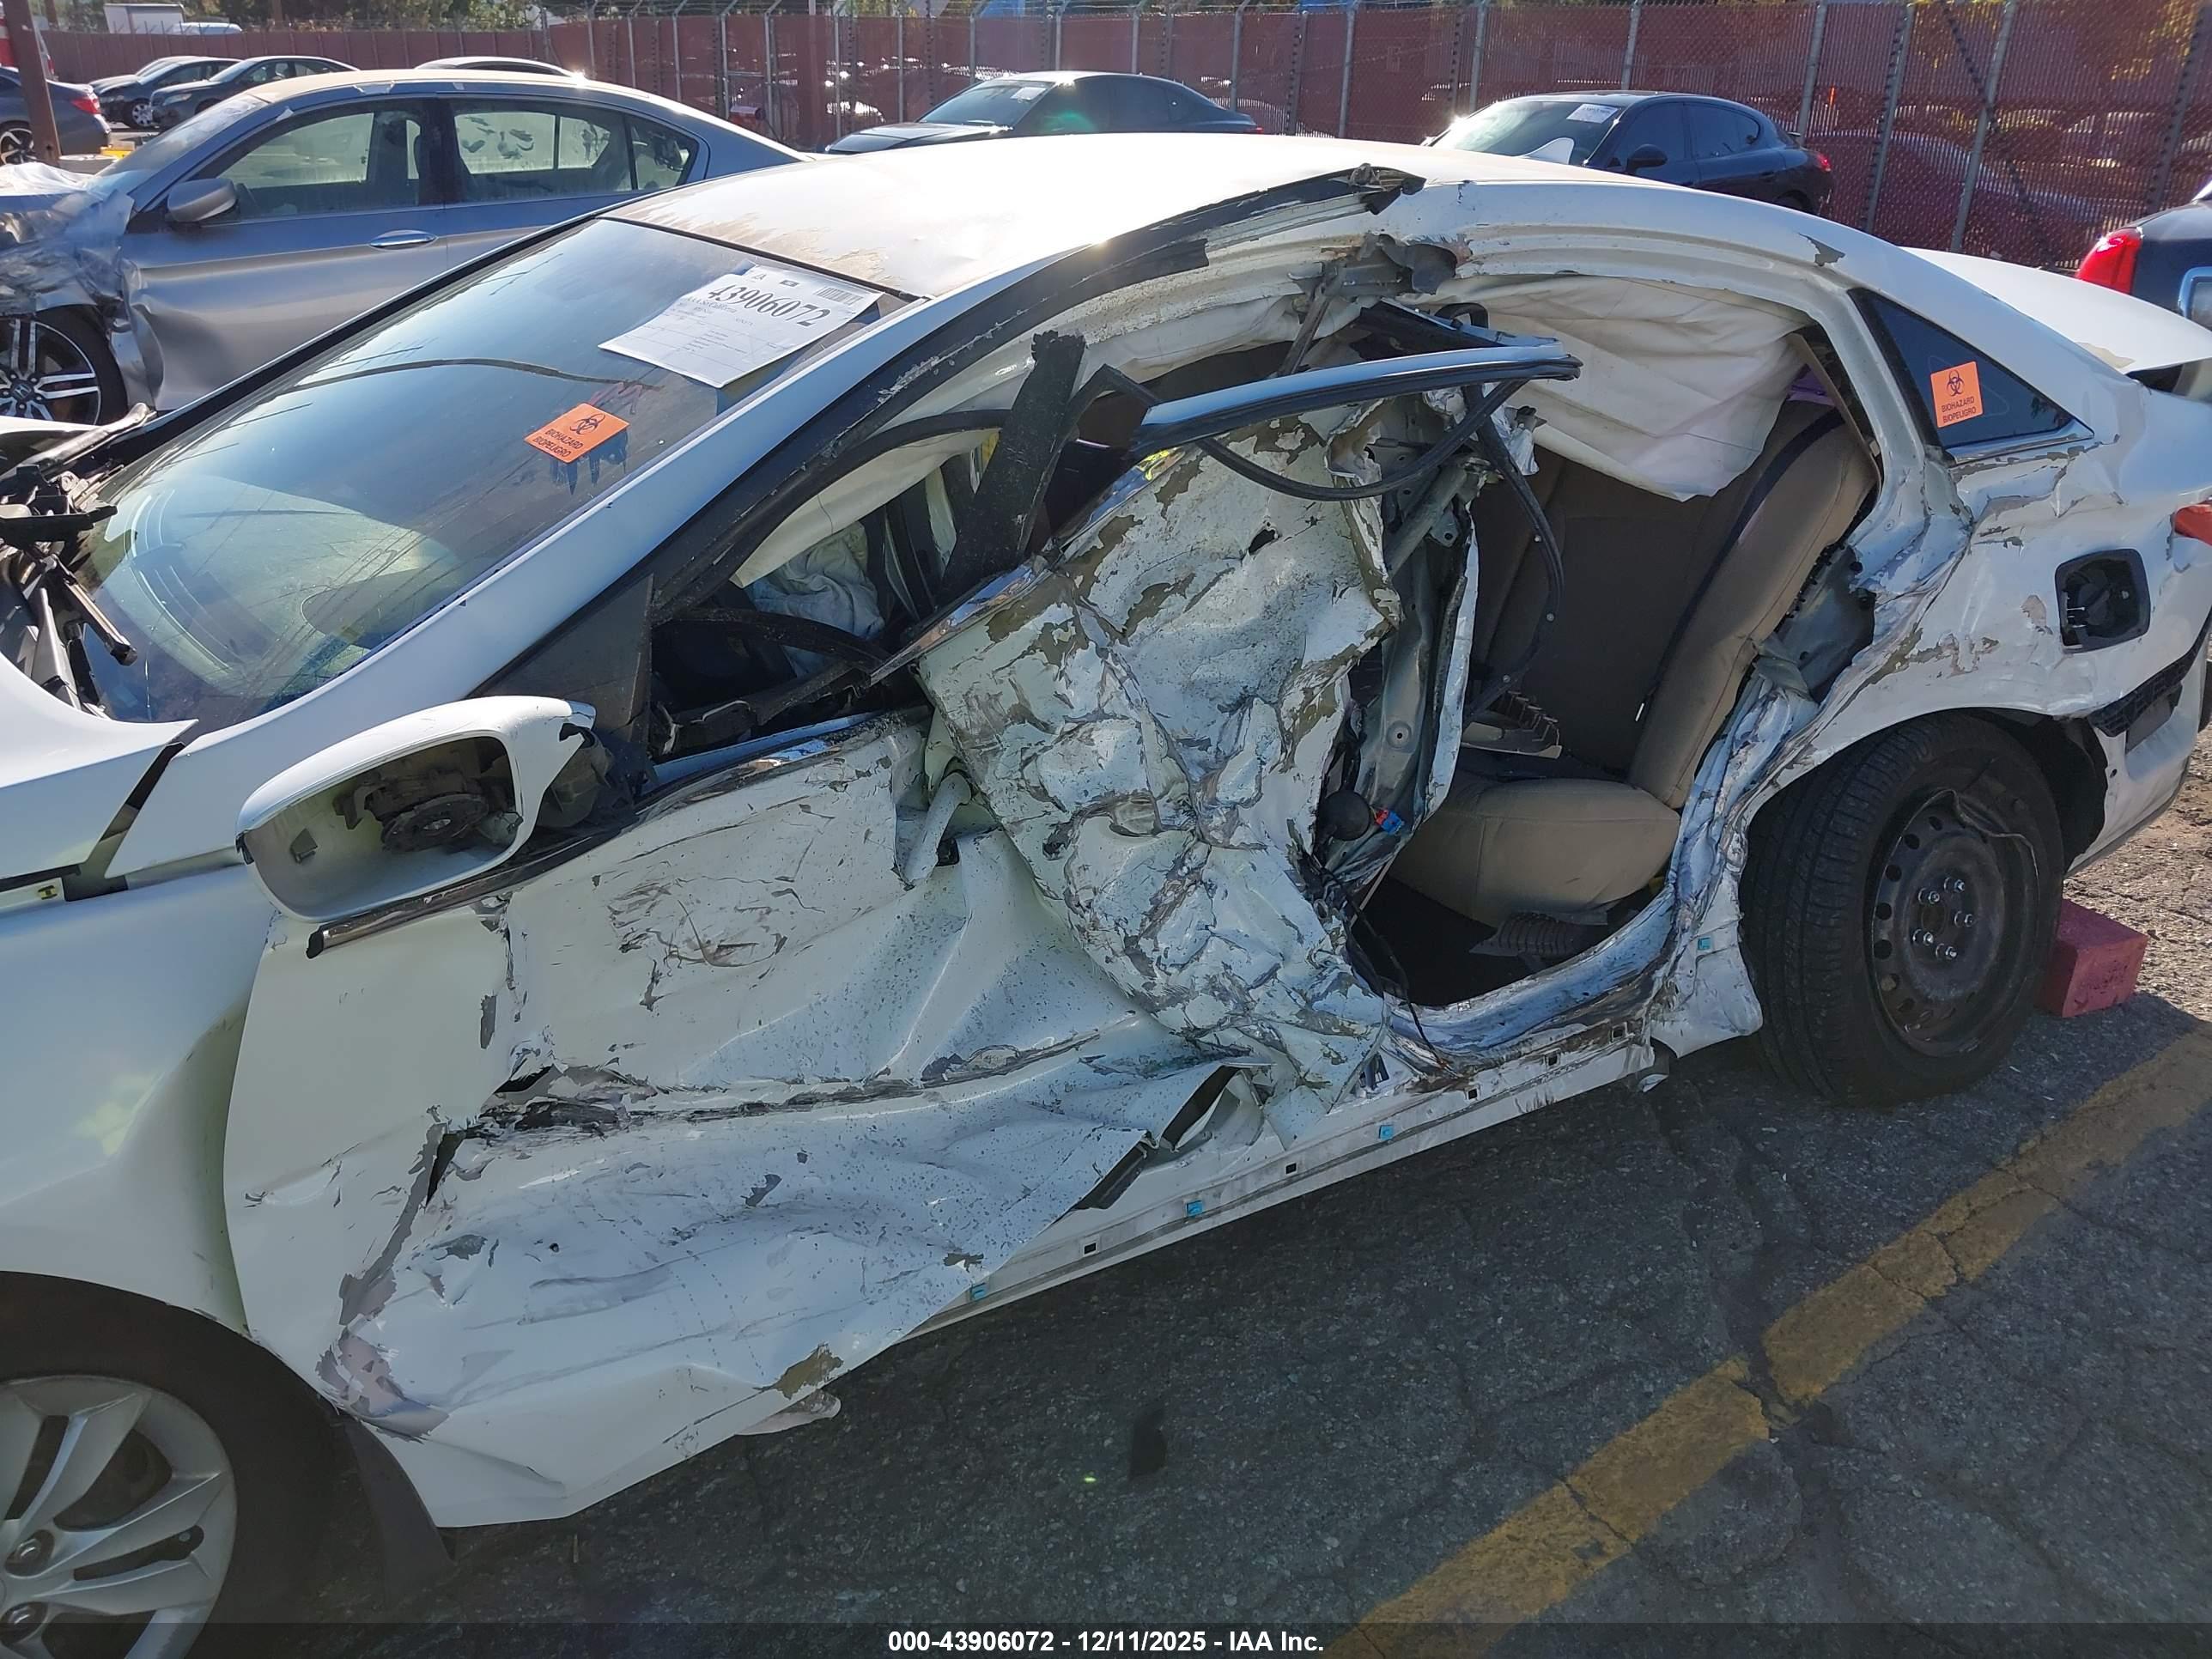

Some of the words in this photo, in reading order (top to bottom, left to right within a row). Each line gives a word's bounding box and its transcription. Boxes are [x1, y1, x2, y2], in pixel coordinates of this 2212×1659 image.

[708, 284, 830, 327] 43906072
[1941, 396, 1975, 413] BIOHAZARD
[1942, 406, 1977, 423] BIOPELIGRO
[532, 435, 572, 458] BIOPELIGRO
[544, 428, 584, 450] BIOHAZARD
